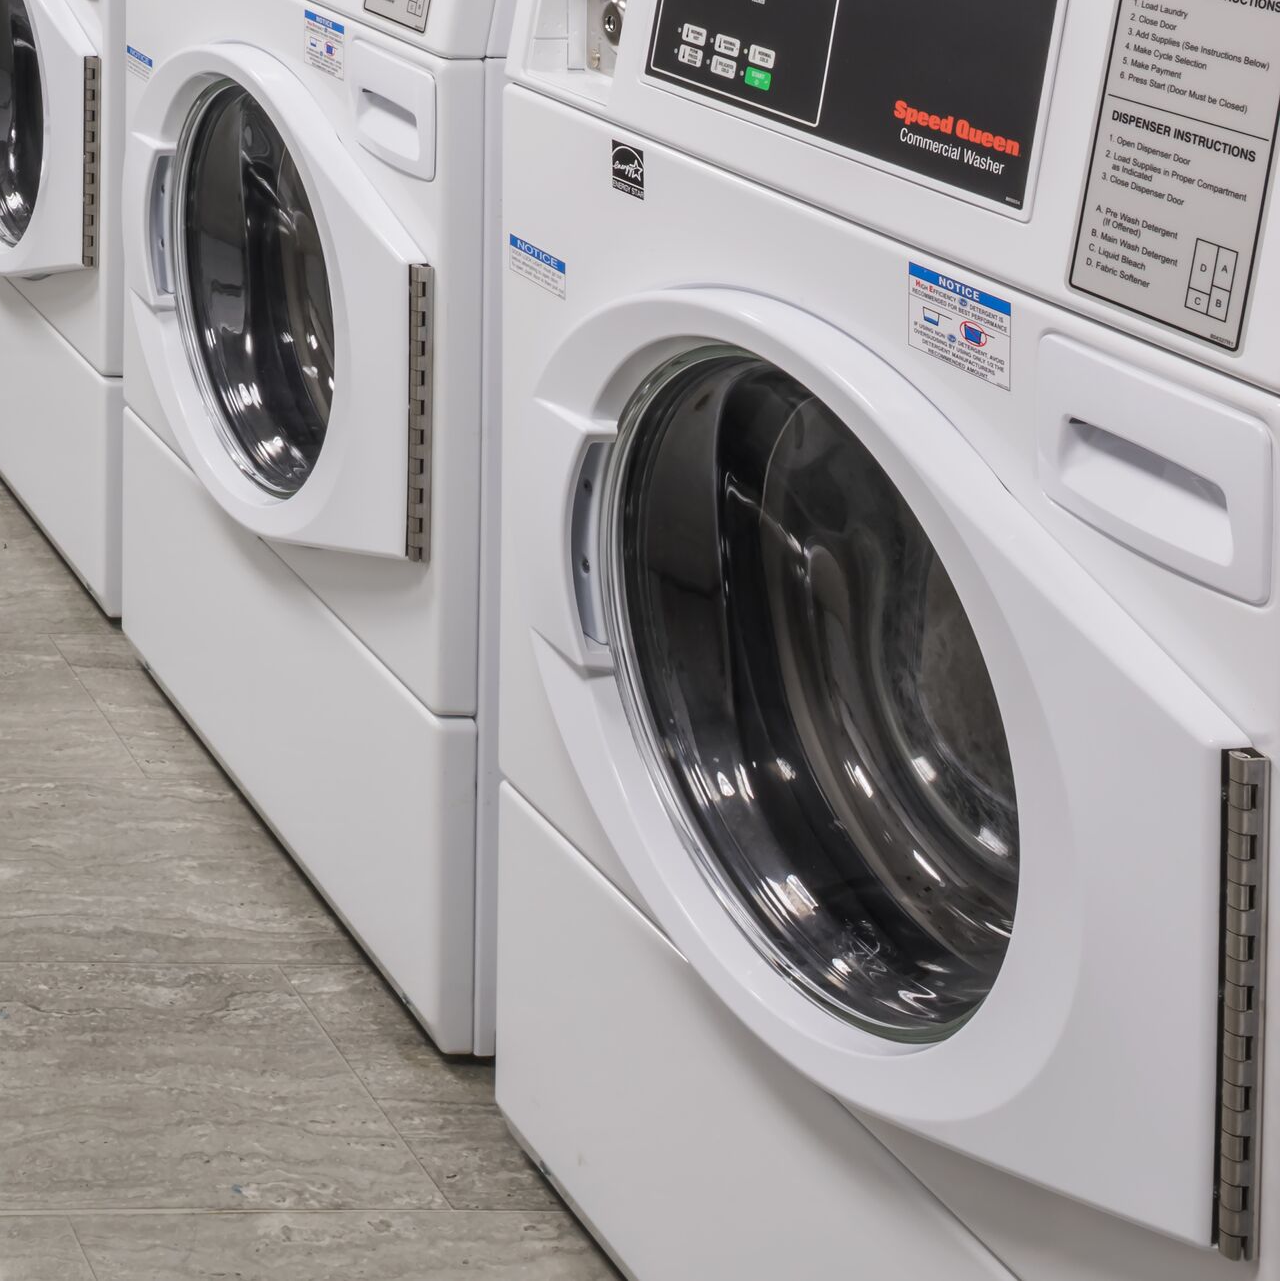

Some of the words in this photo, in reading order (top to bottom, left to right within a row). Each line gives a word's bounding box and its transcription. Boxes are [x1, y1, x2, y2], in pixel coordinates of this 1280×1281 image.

[316, 15, 333, 29] NOTICE
[1130, 13, 1136, 22] 2.
[1139, 15, 1158, 27] Close
[1160, 20, 1177, 31] Door
[1134, 0, 1139, 7] 1.
[1141, 0, 1158, 12] Load
[1160, 2, 1188, 19] Laundry
[1125, 42, 1131, 52] 4.
[1134, 44, 1152, 55] Make
[1153, 49, 1173, 62] Cycle
[1175, 54, 1207, 70] Selection
[1128, 28, 1134, 37] 3.
[1135, 29, 1149, 40] Add
[1151, 34, 1180, 48] Supplies
[1182, 41, 1199, 52] (See
[1201, 45, 1241, 63] Instructions
[1244, 56, 1270, 71] Below)
[1122, 57, 1129, 66] 5.
[1131, 59, 1149, 70] Make
[1151, 64, 1182, 79] Payment
[1120, 71, 1126, 80] 6.
[1128, 73, 1147, 85] Press
[1149, 79, 1165, 90] Start
[1167, 83, 1187, 96] (Door
[1189, 90, 1206, 102] Must
[1208, 95, 1217, 105] be
[1219, 98, 1248, 114] Closed)
[894, 100, 954, 135] Speed
[955, 119, 1020, 157] Queen
[1111, 110, 1171, 137] DISPENSER
[1173, 128, 1257, 163] INSTRUCTIONS
[900, 127, 960, 161] Commercial
[963, 148, 1005, 175] Washer
[1109, 134, 1114, 143] 1.
[1117, 136, 1135, 151] Open
[1137, 142, 1172, 161] Dispenser
[1173, 152, 1191, 166] Door
[1105, 150, 1112, 159] 2.
[1113, 152, 1131, 165] Load
[1132, 157, 1162, 175] Supplies
[1163, 168, 1170, 176] in
[1171, 170, 1196, 187] Proper
[1197, 178, 1247, 202] Compartment
[1111, 163, 1120, 172] as
[1122, 165, 1153, 182] Indicated
[1102, 172, 1108, 181] 3.
[1110, 174, 1129, 187] Close
[1131, 181, 1165, 200] Dispenser
[1166, 193, 1185, 207] Door
[1096, 204, 1103, 214] A.
[1105, 207, 1118, 219] Pre
[1120, 212, 1140, 226] Wash
[1142, 219, 1178, 240] Detergent
[1102, 217, 1110, 227] (If
[1112, 219, 1142, 239] Offered)
[517, 239, 558, 269] NOTICE
[1089, 243, 1096, 252] C.
[1098, 246, 1119, 262] Liquid
[1121, 255, 1146, 271] Bleach
[1091, 228, 1099, 238] B.
[1101, 231, 1118, 245] Main
[1120, 238, 1140, 253] Wash
[1142, 246, 1178, 267] Detergent
[1086, 257, 1094, 267] D.
[1096, 261, 1118, 277] Fabric
[1120, 270, 1150, 288] Softener
[1200, 264, 1207, 273] D
[1221, 265, 1228, 274] A
[938, 277, 980, 300] NOTICE
[1194, 297, 1201, 306] C
[912, 287, 947, 307] RECOMMENDED
[948, 303, 957, 312] FOR
[958, 307, 970, 316] BEST
[971, 313, 1007, 333] PERFORMANCE
[969, 304, 998, 319] DETERGENT
[1215, 299, 1222, 308] B
[919, 323, 933, 332] USING
[935, 329, 945, 338] NON
[922, 339, 950, 355] DETERGENT
[928, 348, 965, 370] RECOMMENDED
[956, 346, 971, 358] USING
[972, 354, 986, 364] ONLY
[994, 363, 1004, 373] THE
